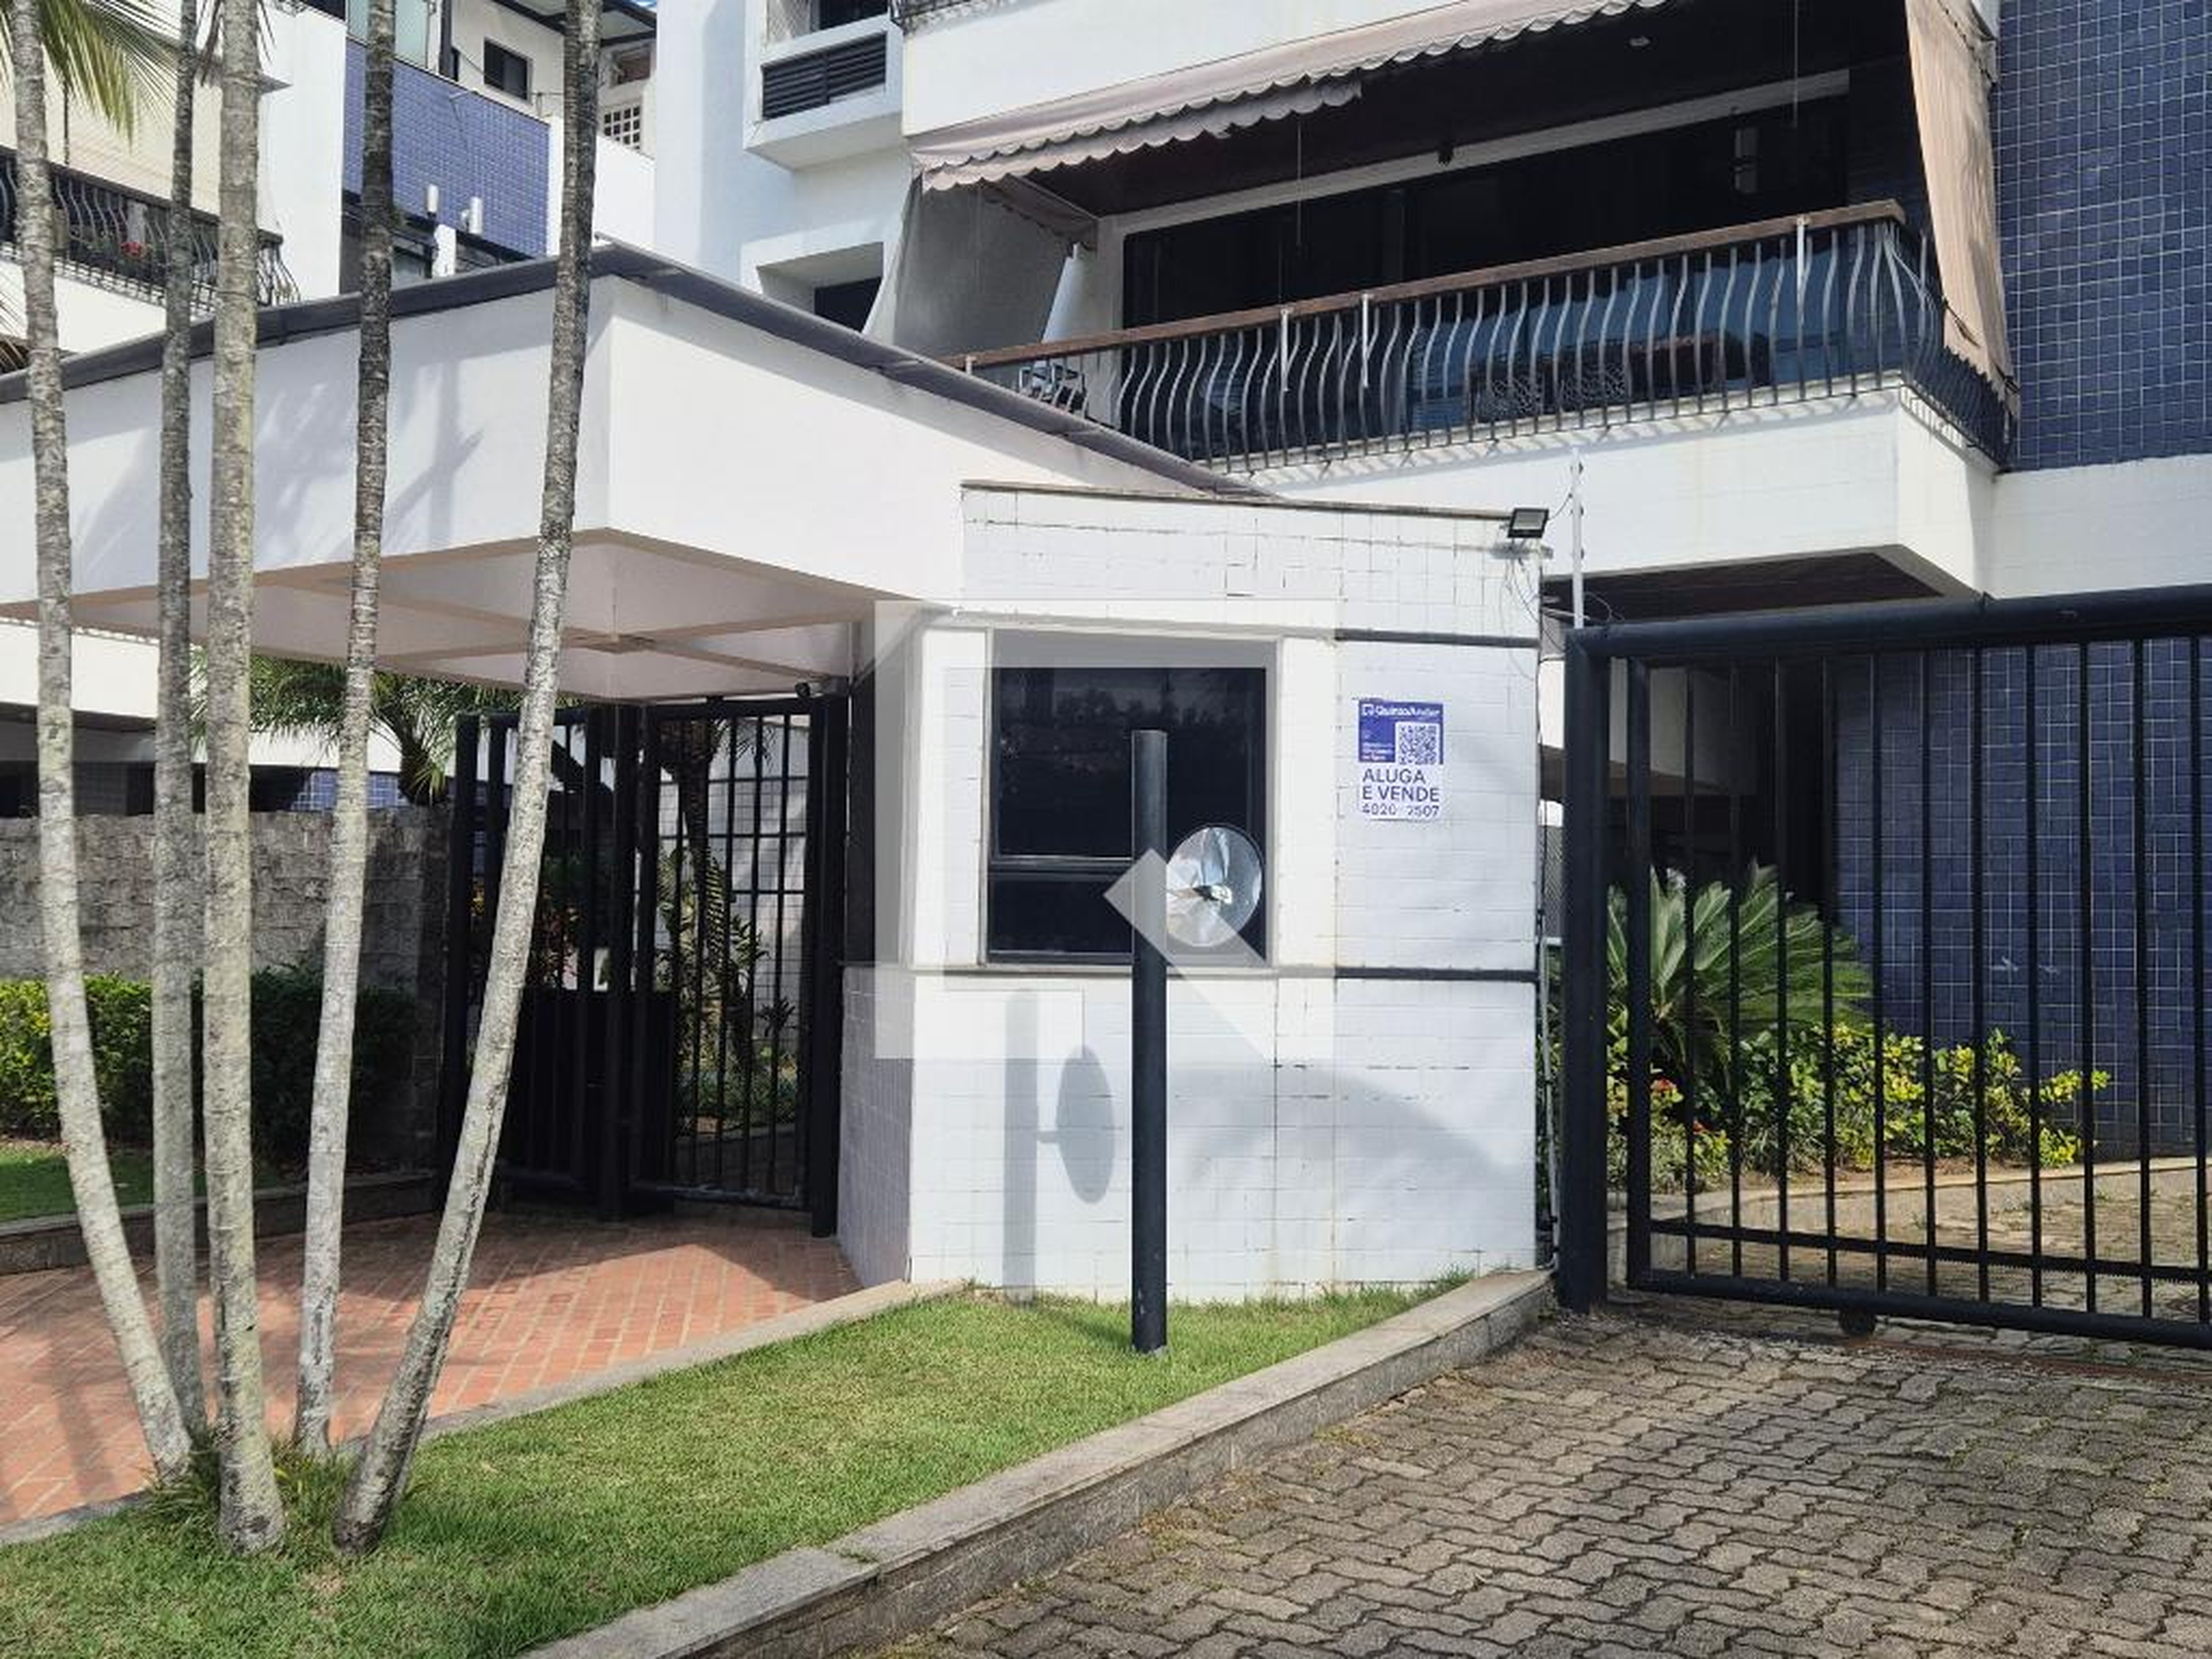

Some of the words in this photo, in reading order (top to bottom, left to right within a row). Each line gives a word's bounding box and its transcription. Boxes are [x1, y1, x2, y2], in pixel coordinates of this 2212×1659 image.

[1362, 768, 1426, 783] ALUGA
[1362, 786, 1372, 800] E
[1377, 786, 1440, 802] VENDE
